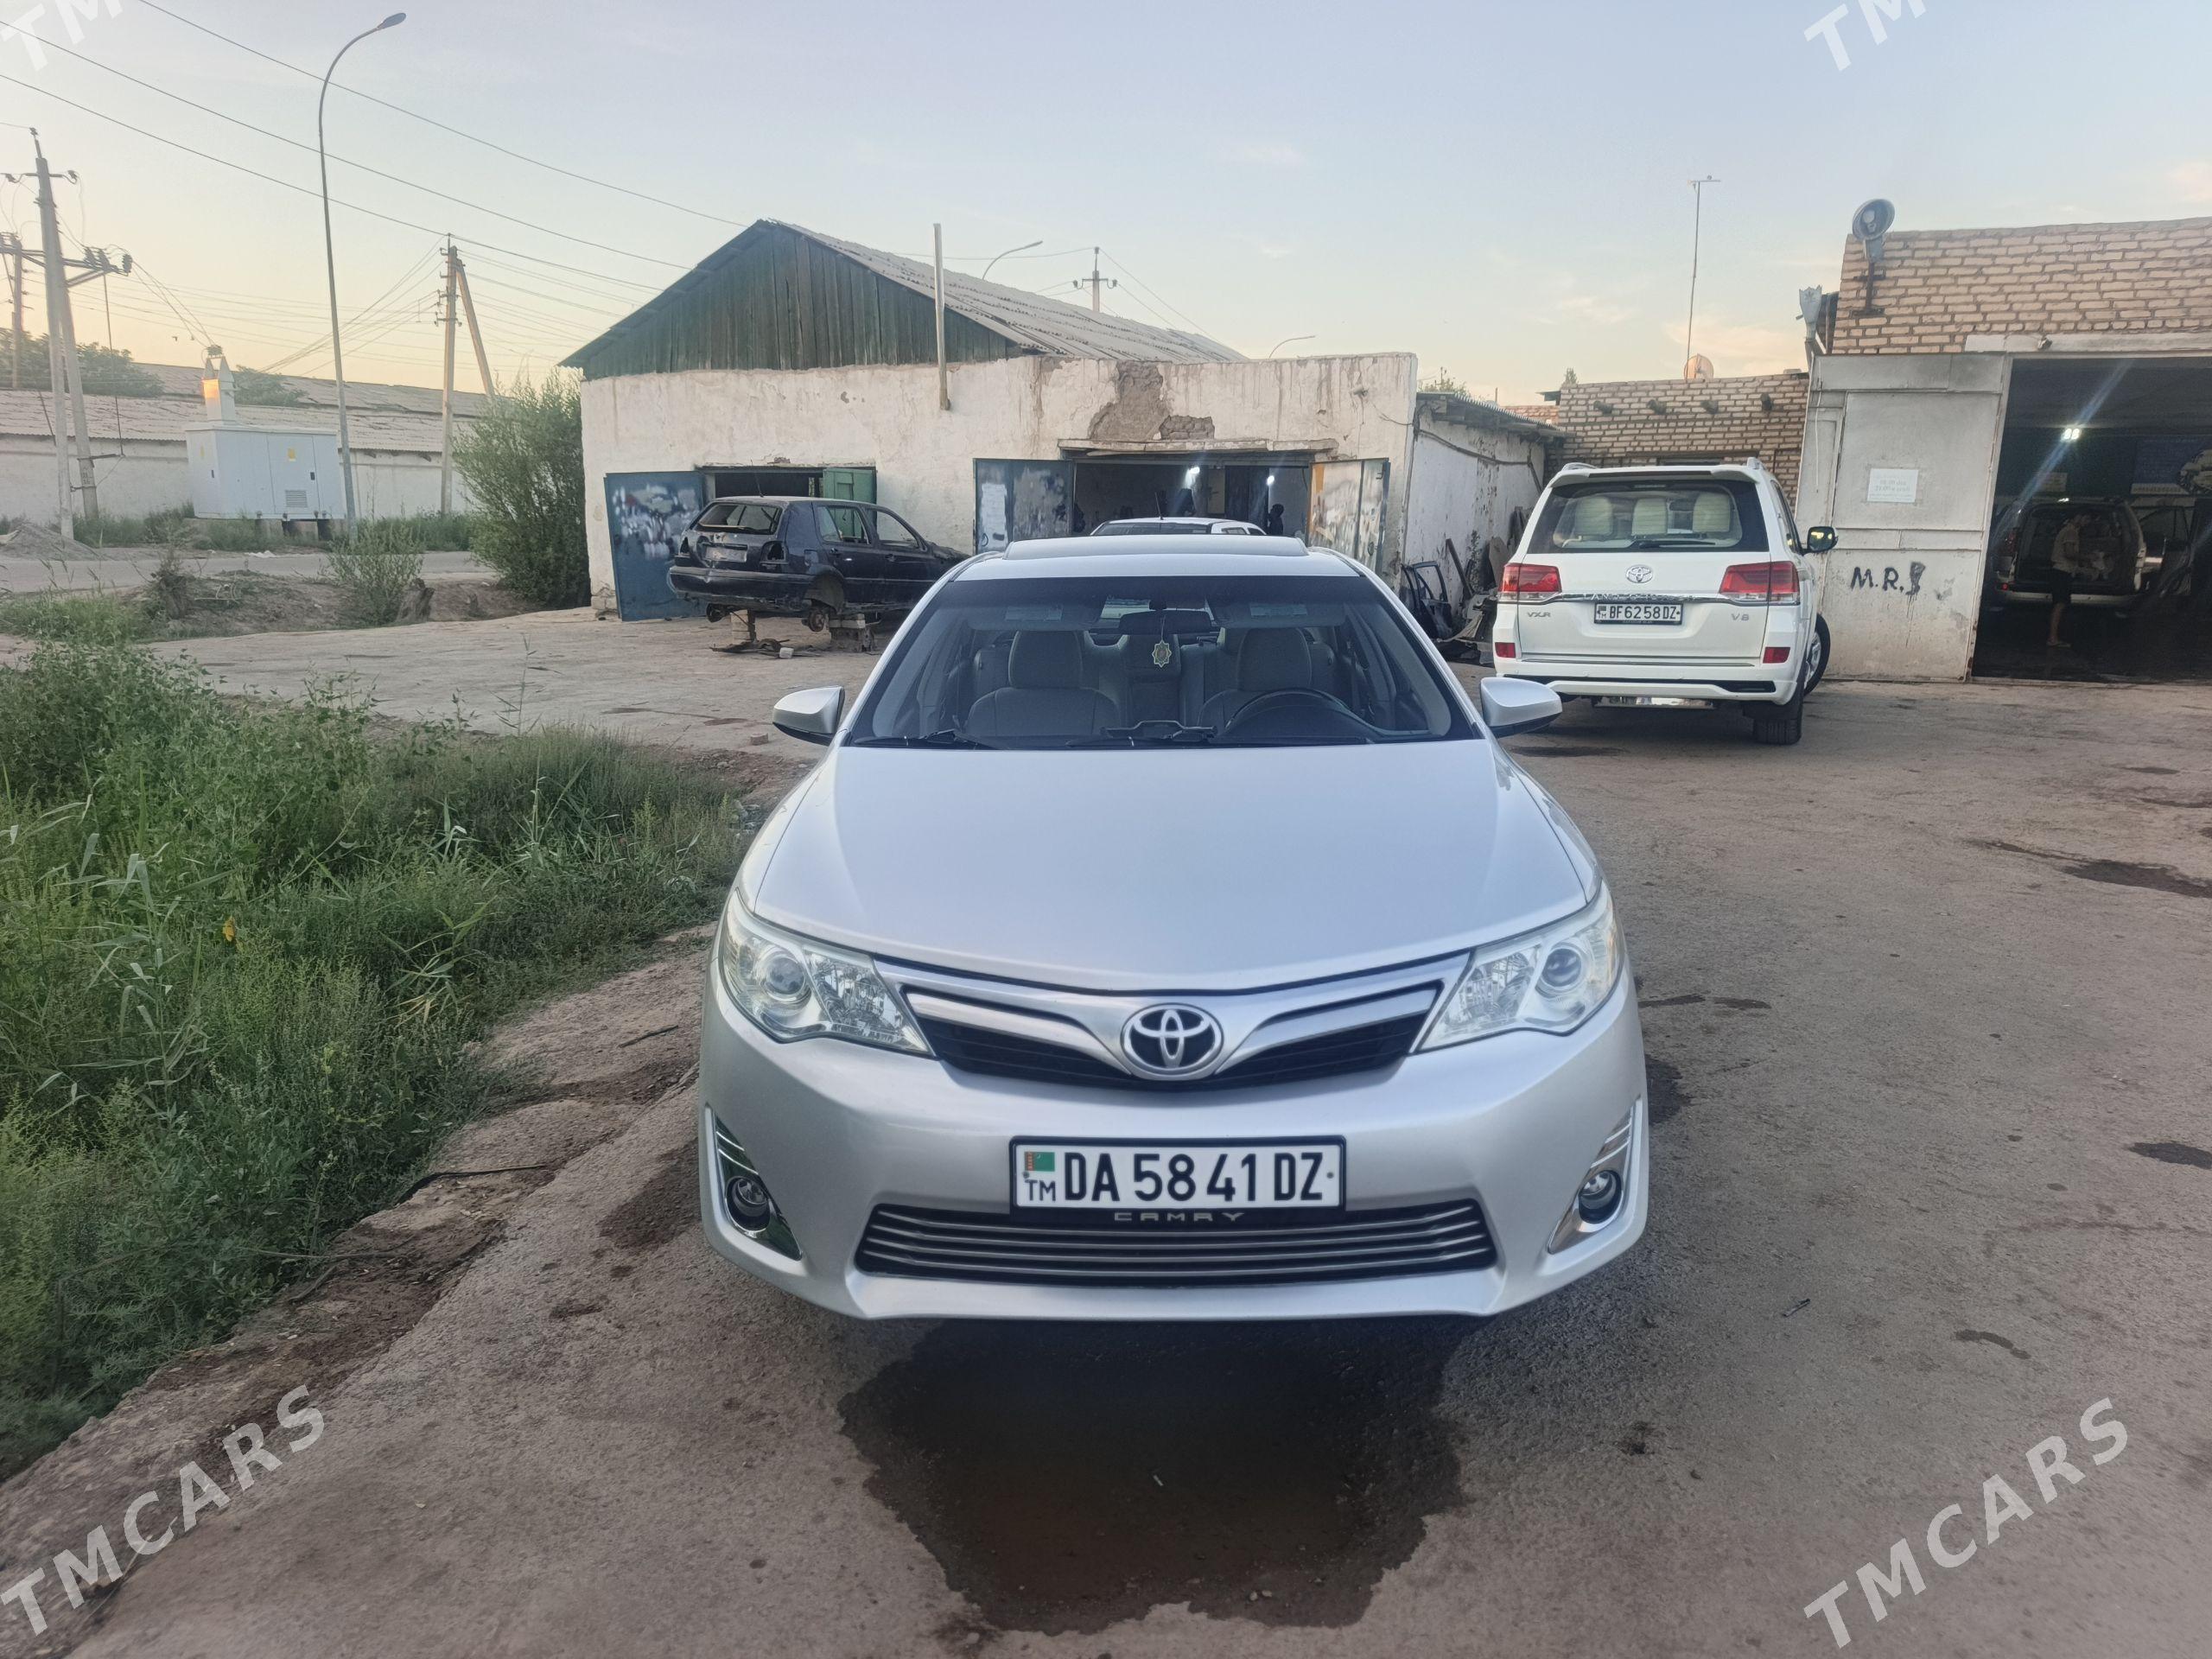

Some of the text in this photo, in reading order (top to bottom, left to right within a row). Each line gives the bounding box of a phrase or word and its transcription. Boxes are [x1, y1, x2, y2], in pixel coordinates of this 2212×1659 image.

[1731, 613, 1750, 621] V8
[1024, 1179, 1056, 1201] TM
[1114, 1212, 1245, 1223] CAMRY
